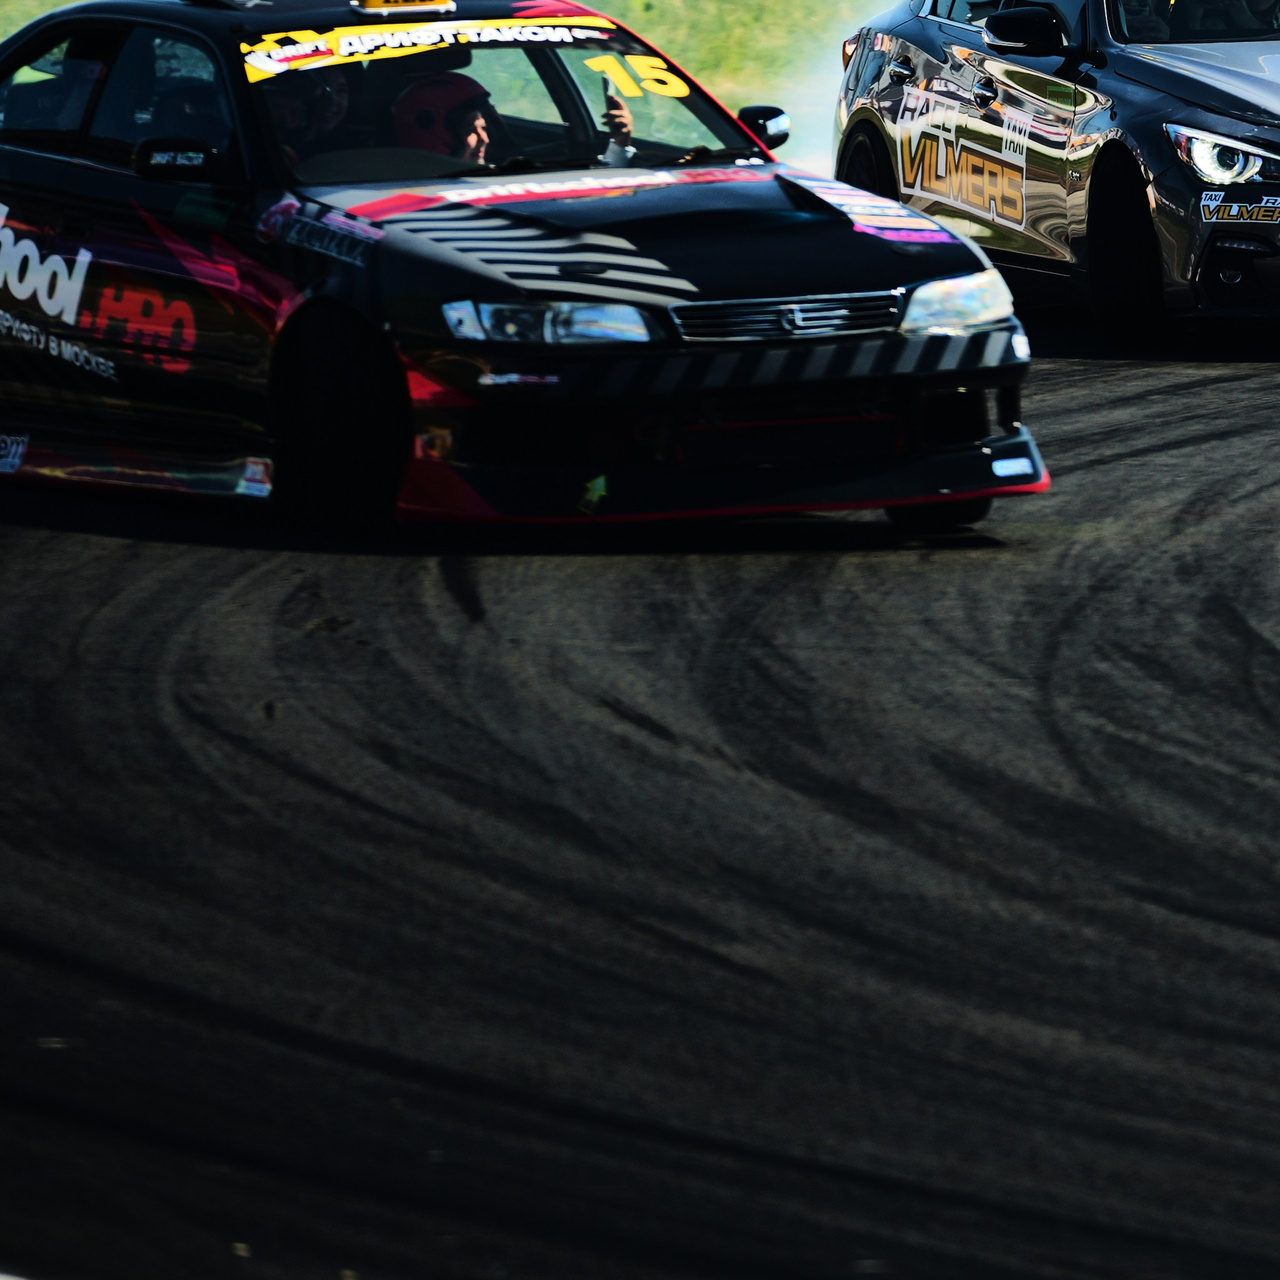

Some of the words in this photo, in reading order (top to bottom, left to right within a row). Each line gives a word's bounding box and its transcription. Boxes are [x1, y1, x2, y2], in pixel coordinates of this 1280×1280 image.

[270, 39, 328, 60] DRIFT
[583, 54, 691, 98] 15
[902, 133, 1024, 222] VILMERS
[1204, 193, 1222, 202] TAXI
